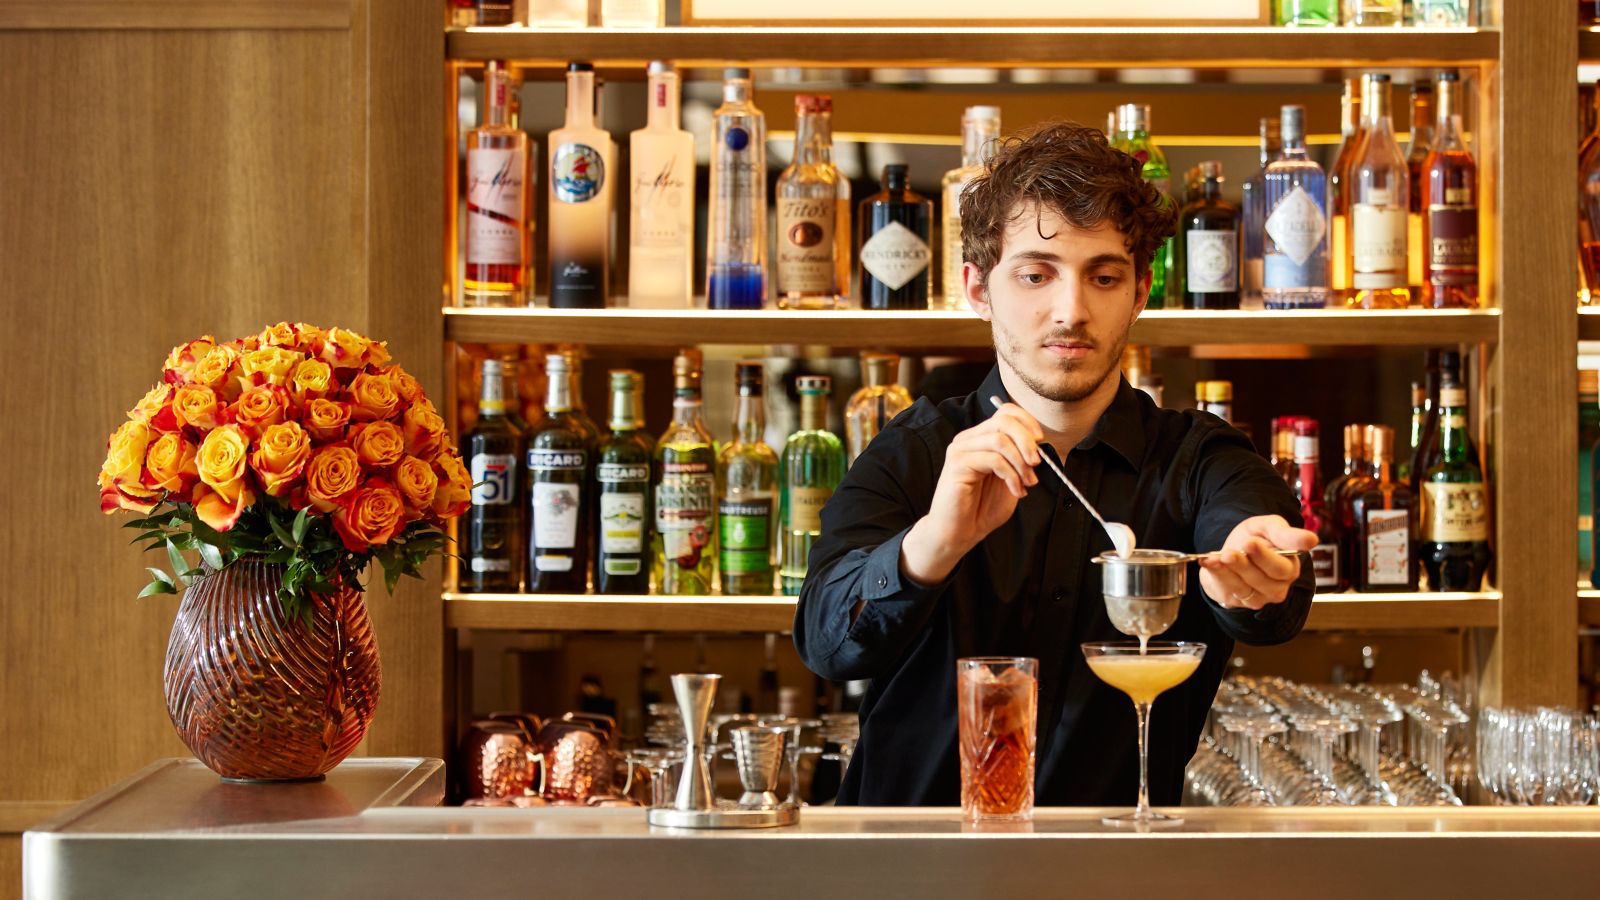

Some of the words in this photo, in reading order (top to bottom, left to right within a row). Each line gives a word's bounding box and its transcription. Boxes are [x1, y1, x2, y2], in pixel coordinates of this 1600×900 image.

[783, 200, 830, 218] Tito's
[530, 452, 582, 466] RICARD
[480, 470, 509, 501] 51
